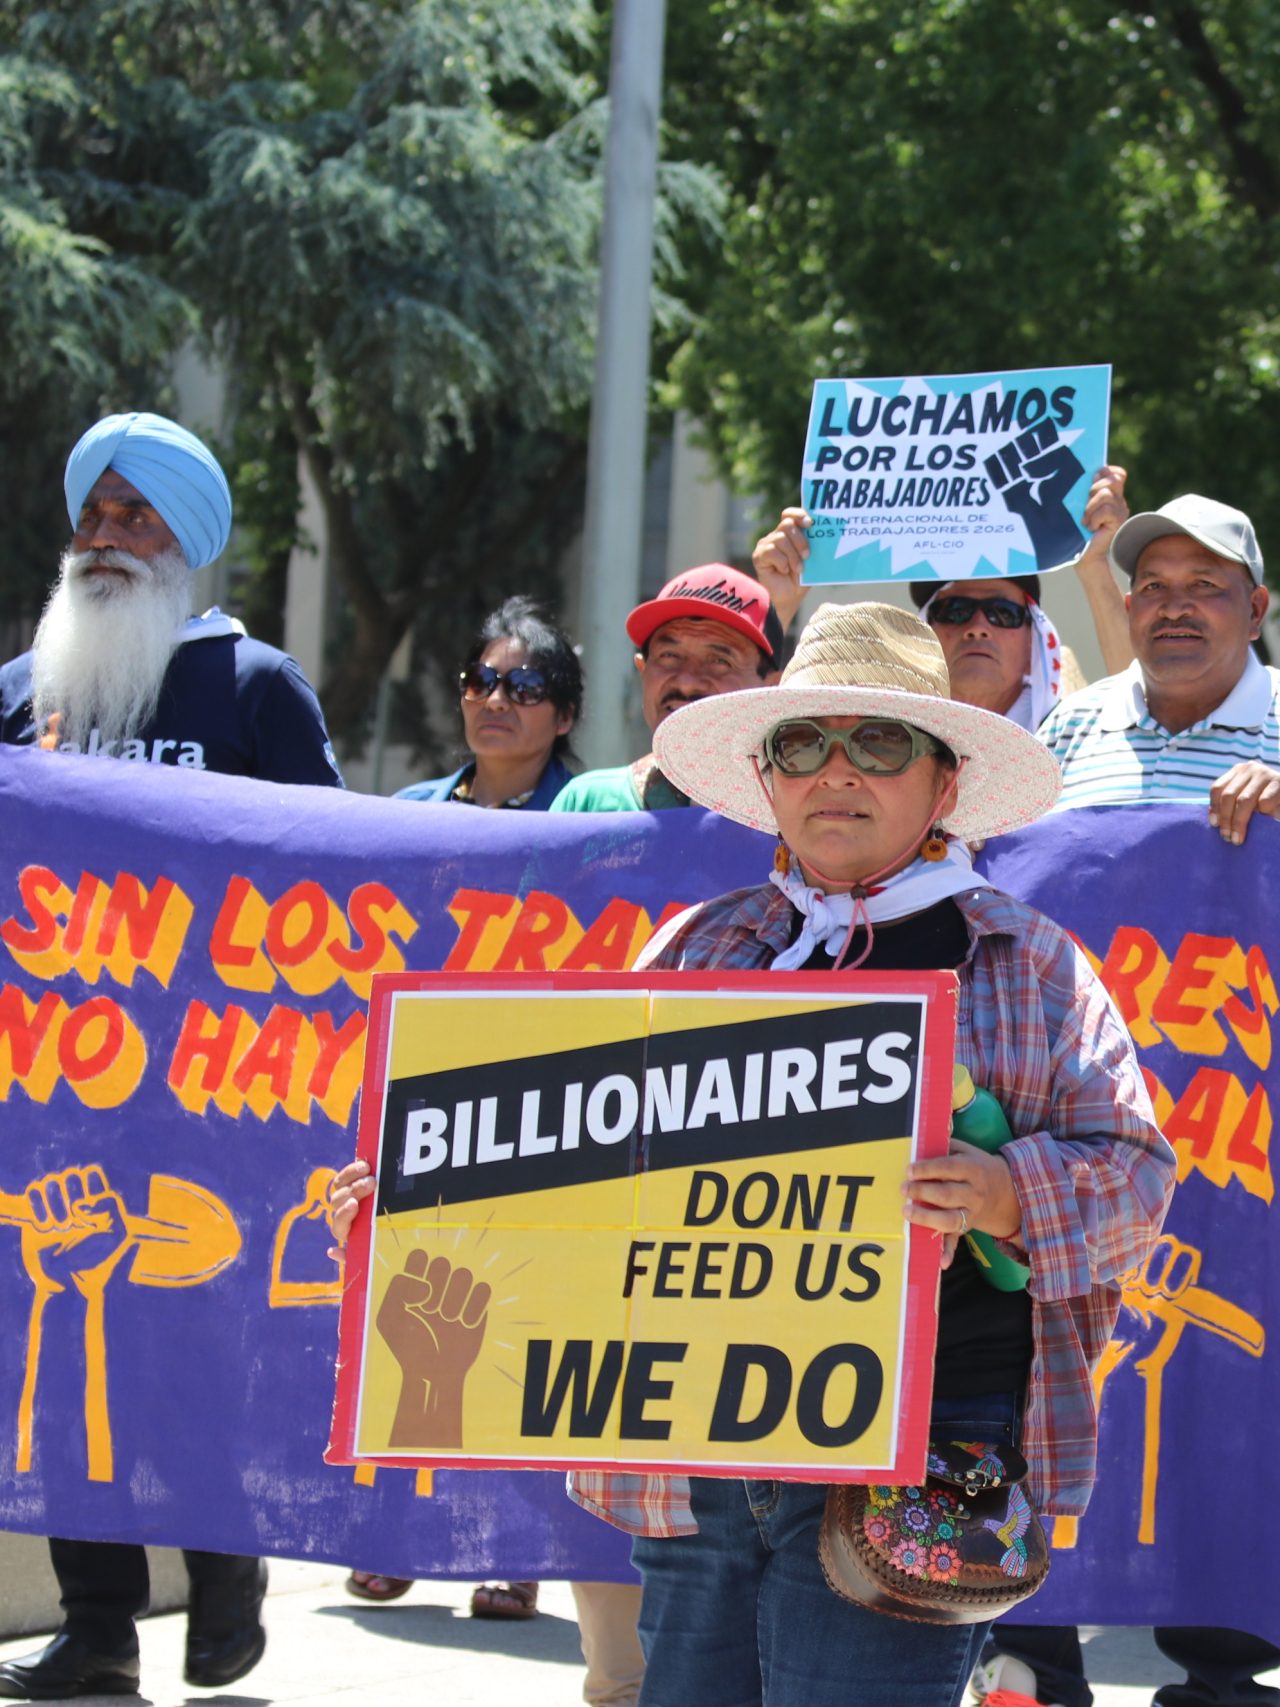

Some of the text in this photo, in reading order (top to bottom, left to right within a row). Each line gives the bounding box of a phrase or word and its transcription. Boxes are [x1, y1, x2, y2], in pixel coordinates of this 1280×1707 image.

[818, 386, 1076, 437] LUCHAMOS
[814, 444, 977, 472] POR LOS
[809, 477, 990, 510] TRABAJADORES
[836, 514, 963, 525] INTERNACIONAL
[967, 514, 989, 523] DE
[806, 524, 1015, 539] LOS TRABAJADORES 2026
[913, 540, 965, 549] AFL-CIO
[2, 865, 195, 989] SIN
[209, 875, 418, 1000] LOS
[0, 983, 147, 1109] NO
[168, 1000, 366, 1128] HAY
[403, 1031, 913, 1176] BILLIONAIRES
[683, 1169, 875, 1232] DONT
[623, 1241, 885, 1302] FEED US
[520, 1338, 885, 1449] WE DO
